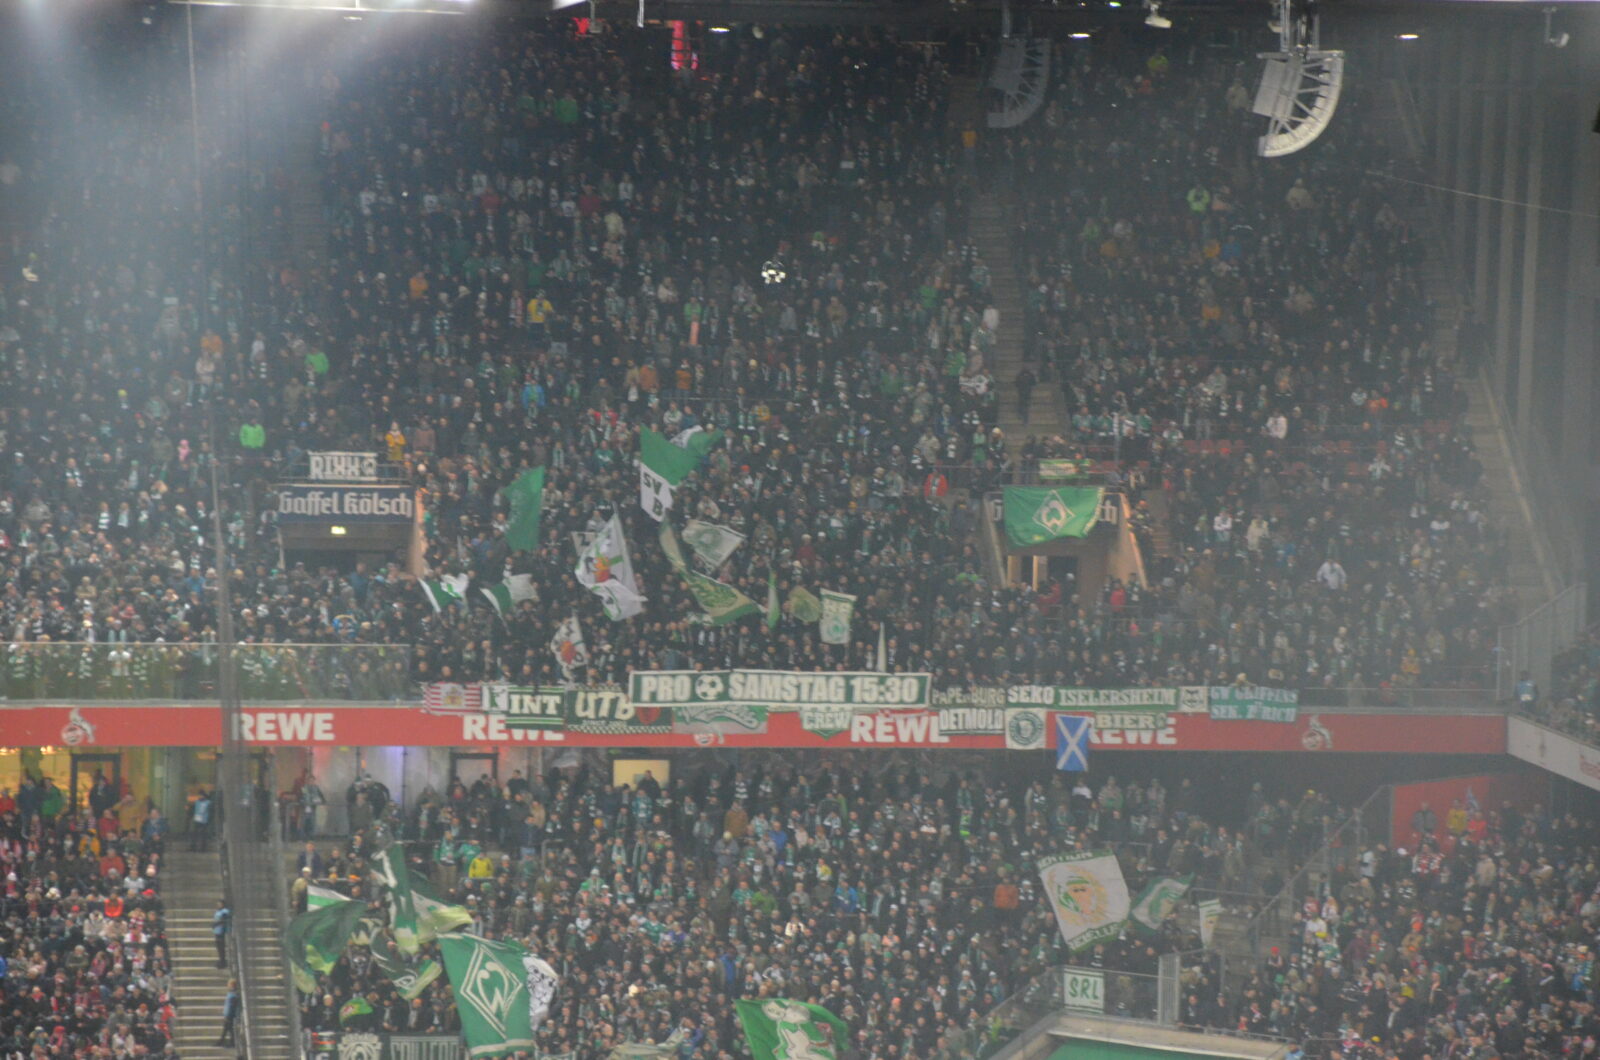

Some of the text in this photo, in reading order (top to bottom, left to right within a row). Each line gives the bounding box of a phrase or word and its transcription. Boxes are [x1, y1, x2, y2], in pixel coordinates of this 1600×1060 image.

[344, 492, 412, 517] Kölsch
[640, 672, 919, 703] PRO SAMSTAG 15:30
[1007, 685, 1055, 705] SEKO
[1059, 688, 1176, 706] ISELERSHEIM
[509, 694, 562, 715] INT
[231, 713, 335, 741] REWE
[802, 711, 851, 730] CREW
[939, 708, 1004, 730] DETMOLD
[1069, 976, 1099, 1000] SRL
